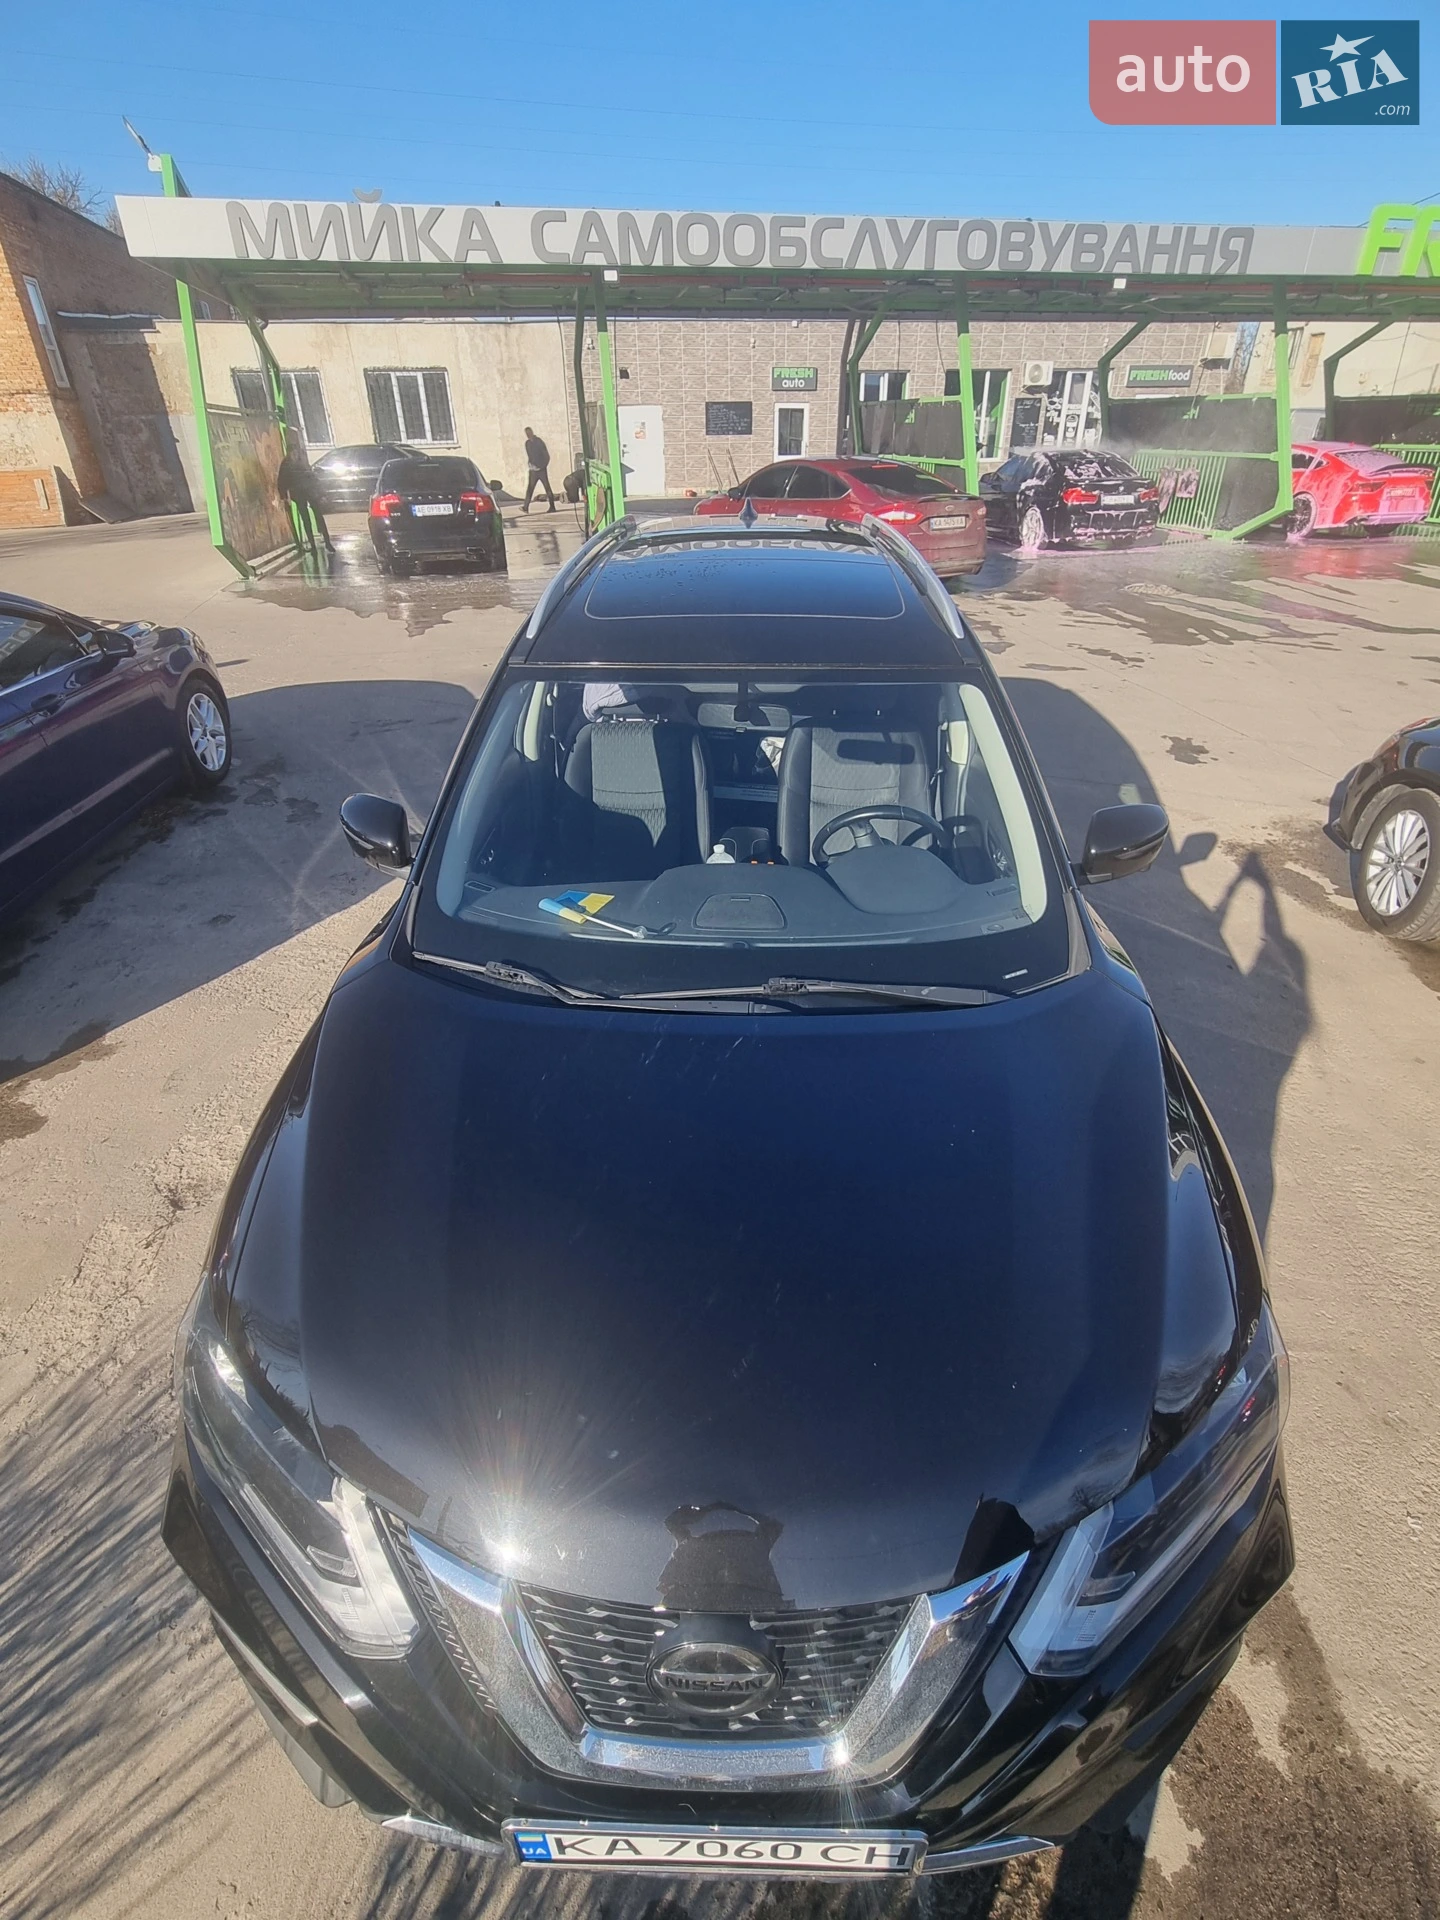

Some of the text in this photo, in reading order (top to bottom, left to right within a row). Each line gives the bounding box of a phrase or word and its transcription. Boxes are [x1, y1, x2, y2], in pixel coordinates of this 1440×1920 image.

[225, 187, 1255, 275] МИЙКА САМООБСЛУГОВУВАННЯ
[773, 367, 814, 379] FRESH
[1129, 369, 1191, 381] FRESH food
[781, 377, 806, 388] auto
[664, 1675, 763, 1691] NISSAN
[521, 1846, 548, 1857] UA
[552, 1835, 914, 1867] KA 7060 CH
